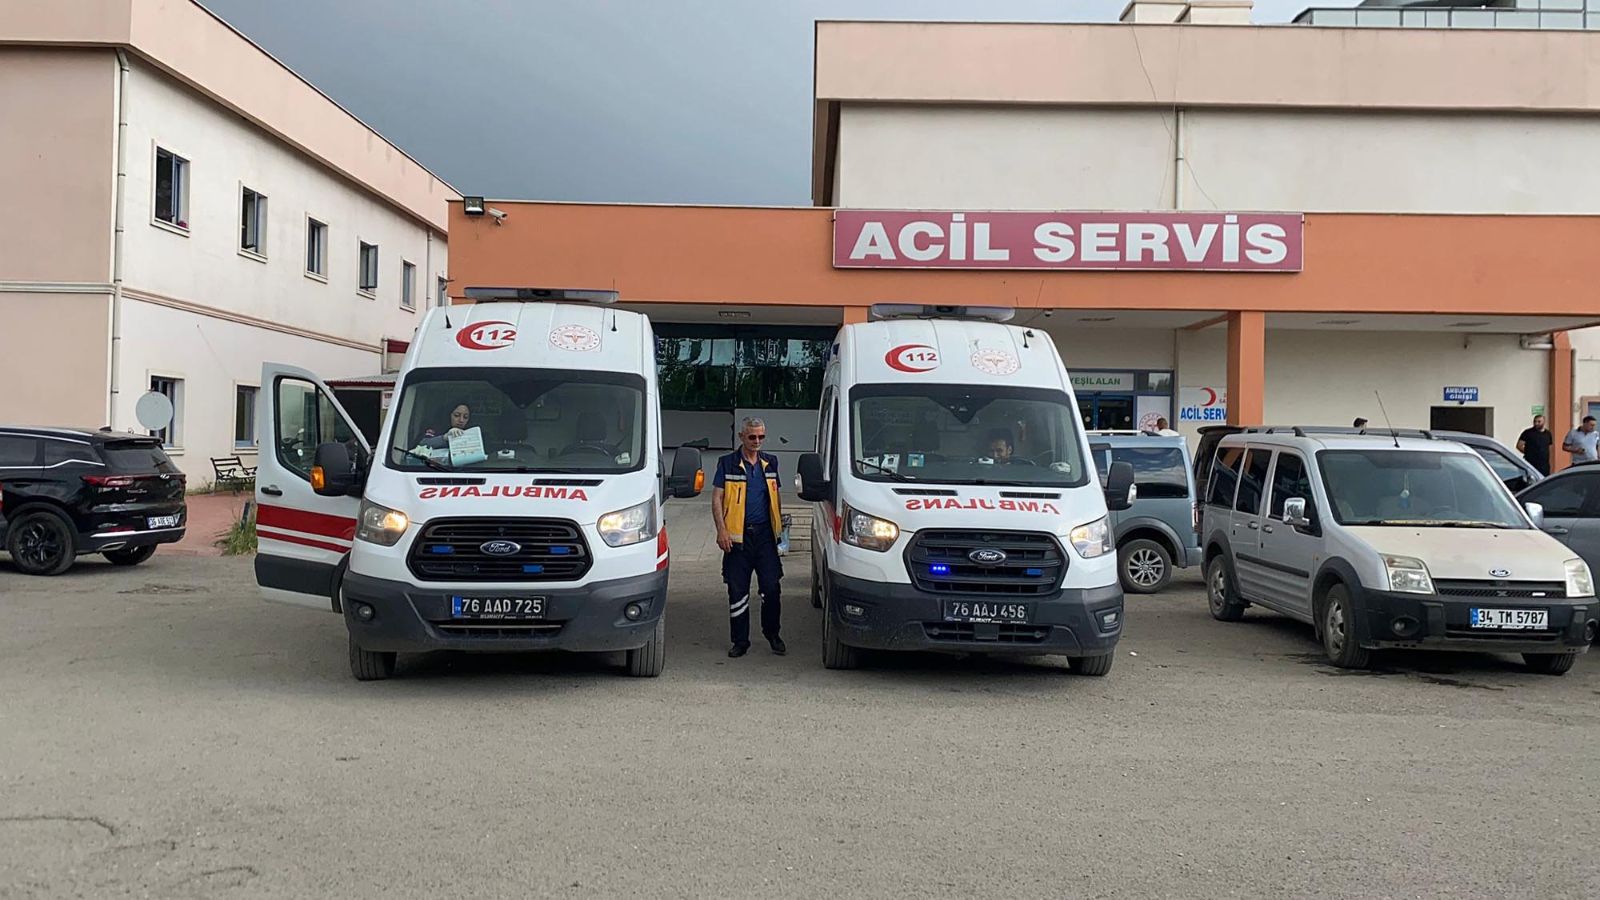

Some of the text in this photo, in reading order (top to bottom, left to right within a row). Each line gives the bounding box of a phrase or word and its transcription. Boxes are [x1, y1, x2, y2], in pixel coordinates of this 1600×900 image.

[849, 213, 1288, 264] ACİL SERVİS
[473, 329, 517, 341] 112
[906, 352, 937, 362] 112
[1070, 376, 1121, 386] YEŞİL ALAN
[1180, 404, 1202, 420] ACİL
[488, 543, 511, 553] Ford
[977, 551, 998, 560] Ford
[462, 599, 480, 612] 76
[484, 599, 511, 613] AAD
[515, 599, 542, 613] 725
[952, 602, 1025, 619] 76 AAJ 456
[1478, 610, 1545, 625] 34 TM 5787
